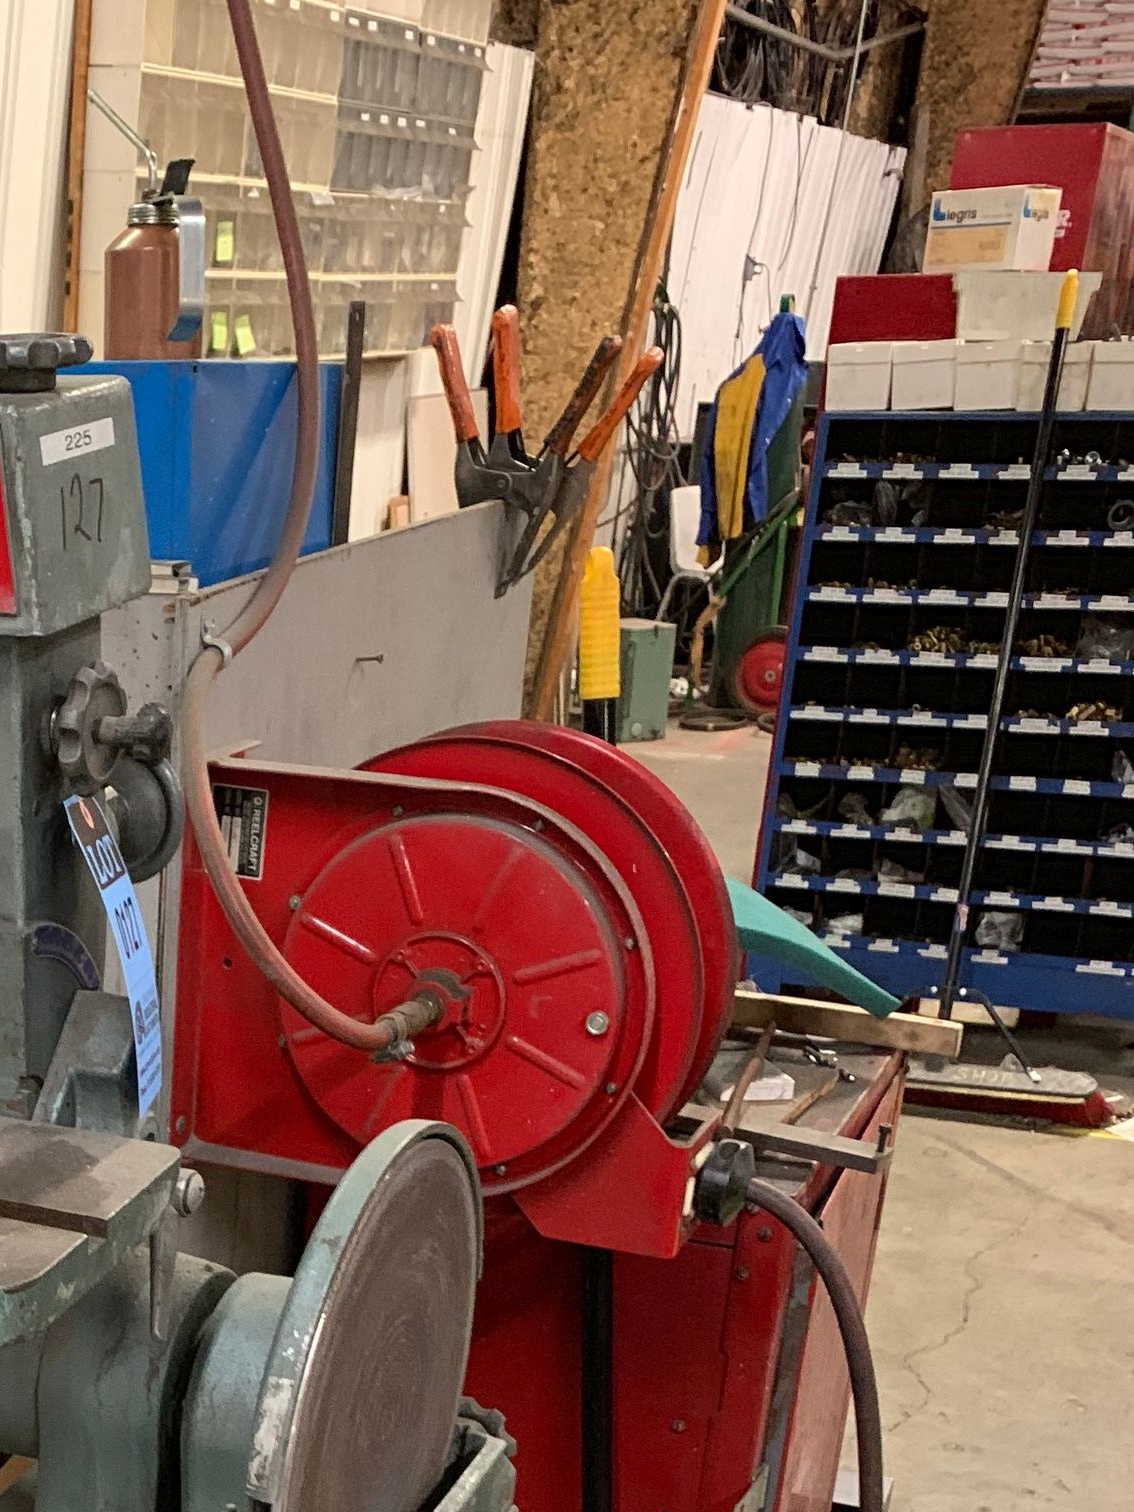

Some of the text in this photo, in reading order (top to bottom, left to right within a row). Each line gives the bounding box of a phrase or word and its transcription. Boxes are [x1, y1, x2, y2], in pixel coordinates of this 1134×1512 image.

[65, 429, 93, 451] 225
[60, 473, 104, 550] 127
[85, 834, 123, 885] LOT
[247, 808, 262, 871] REELCRAFT
